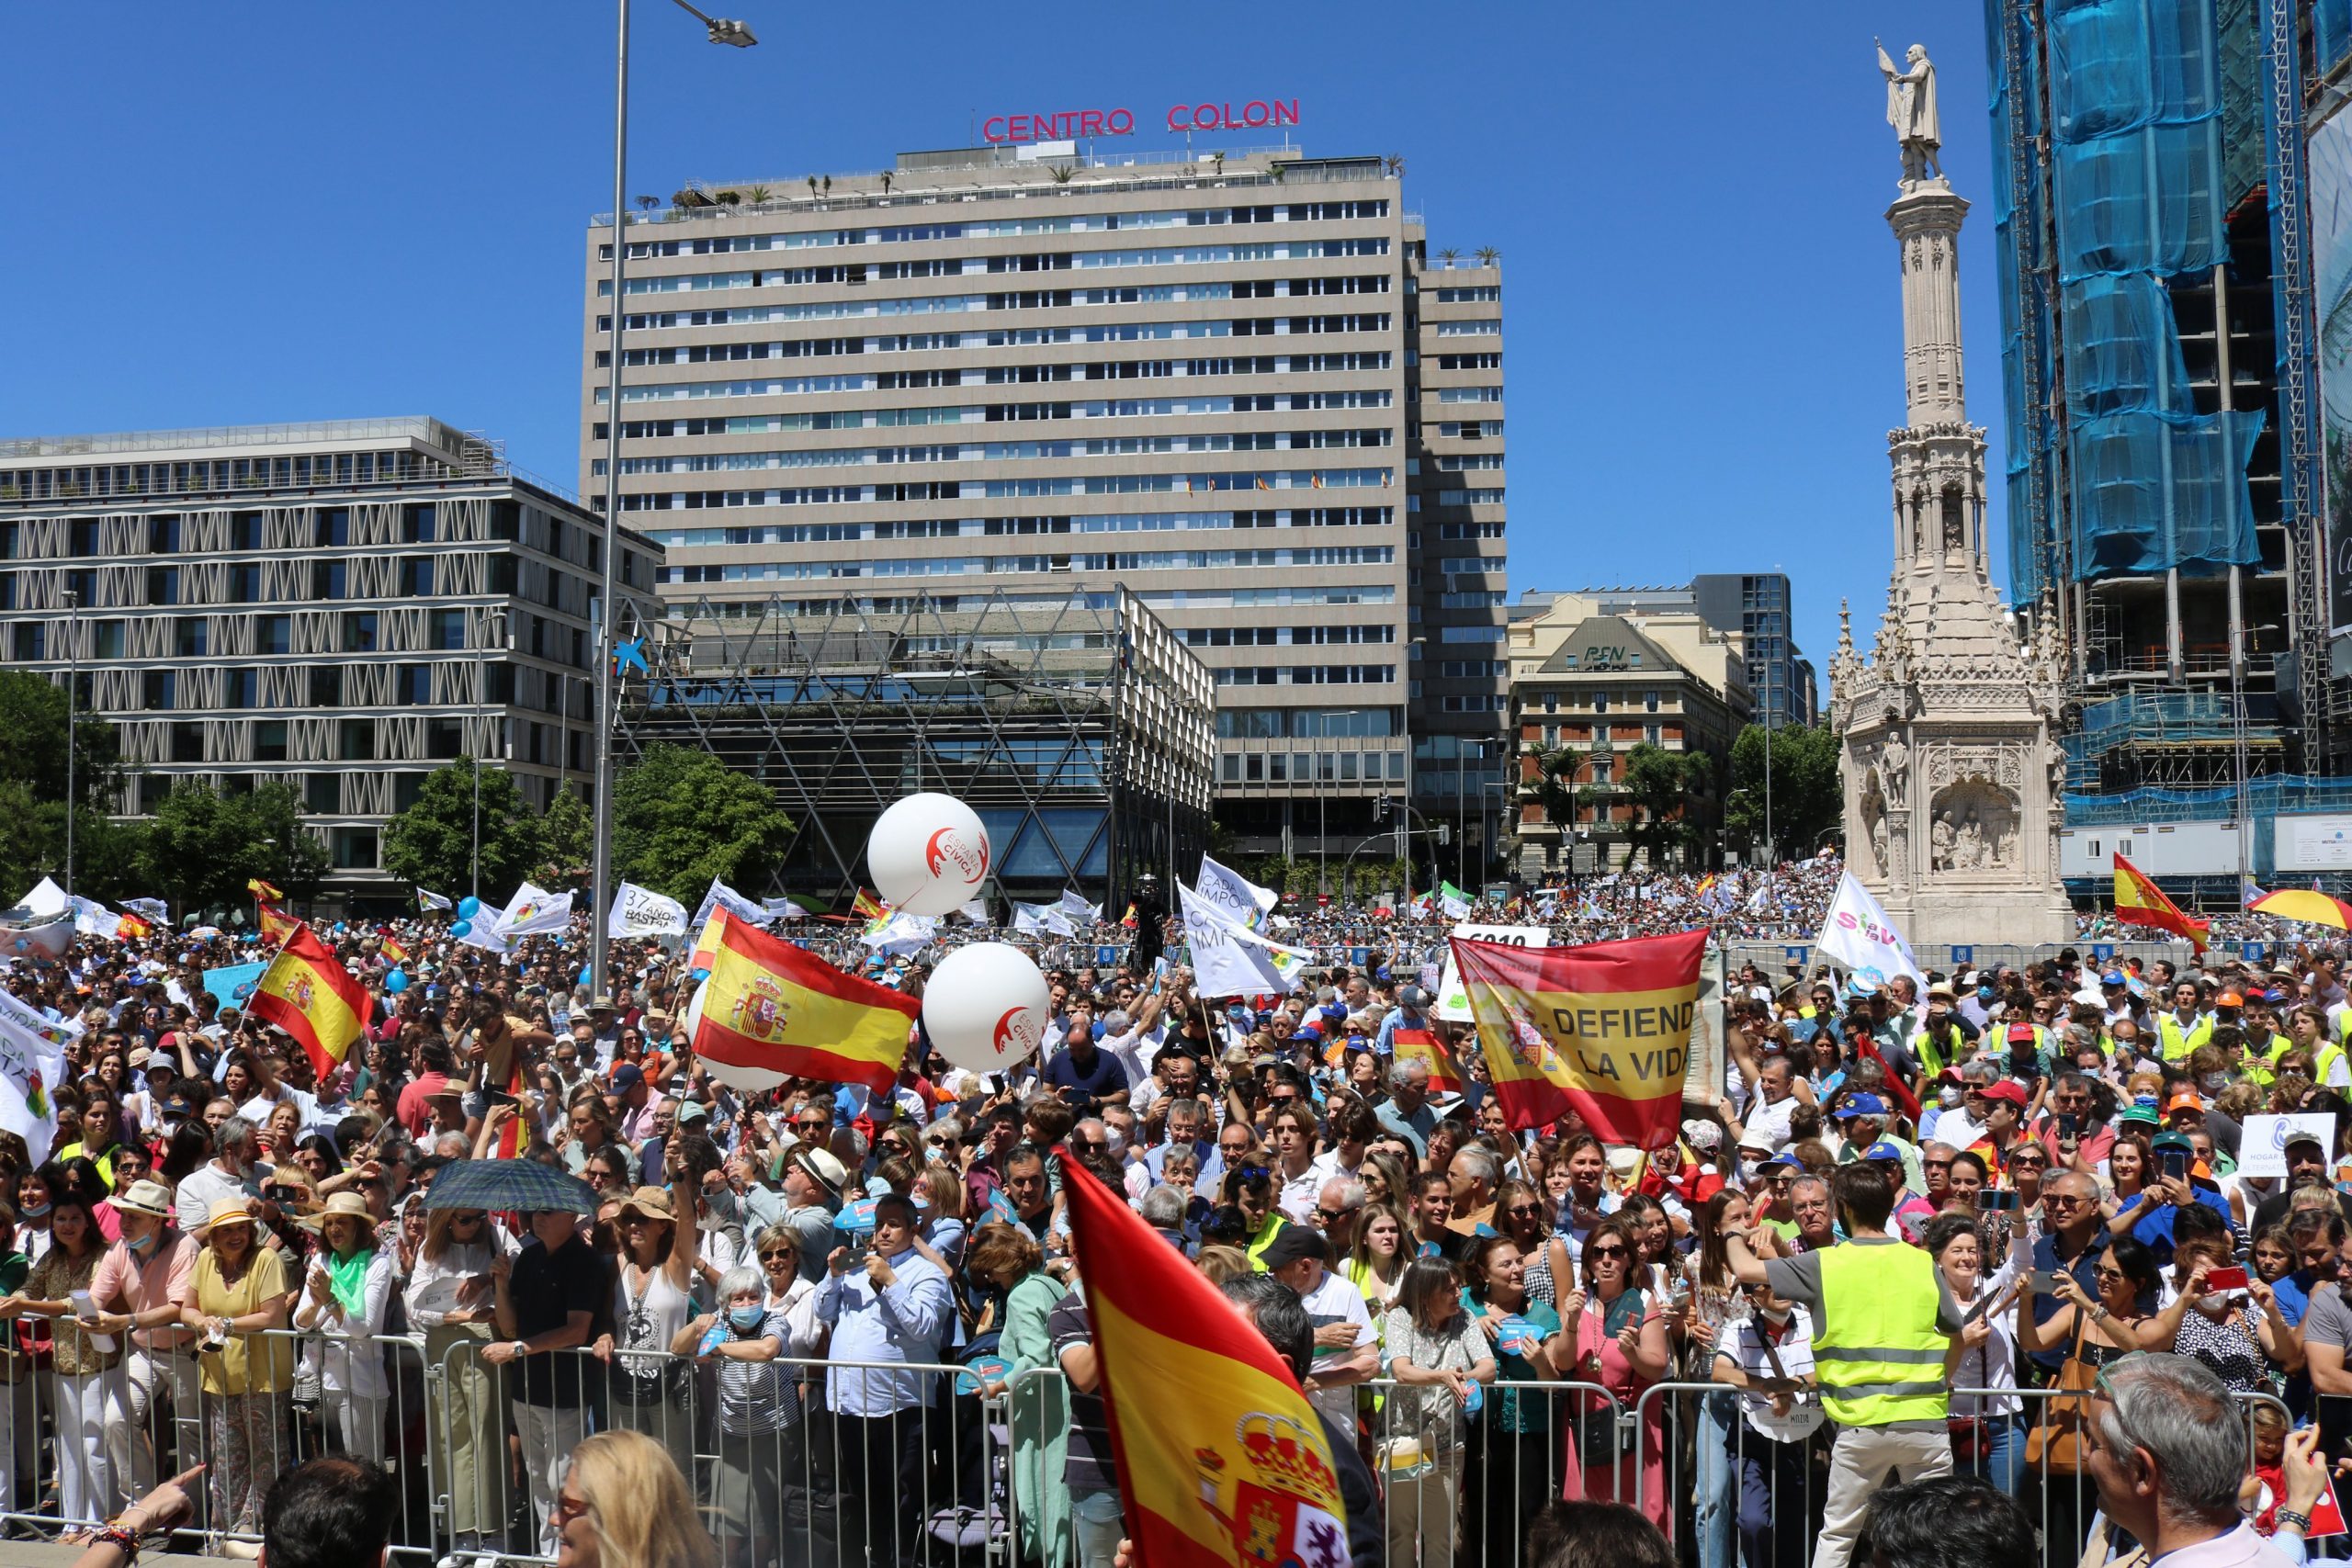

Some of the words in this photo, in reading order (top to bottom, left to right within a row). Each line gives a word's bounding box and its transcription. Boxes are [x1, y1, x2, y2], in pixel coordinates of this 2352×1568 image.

[983, 108, 1134, 142] CENTRO
[1168, 98, 1299, 130] COLON
[1584, 646, 1625, 661] PSN
[1203, 874, 1237, 892] CADA
[626, 889, 650, 909] 37
[1577, 1049, 1621, 1081] LA
[2250, 1153, 2279, 1161] HOGAR
